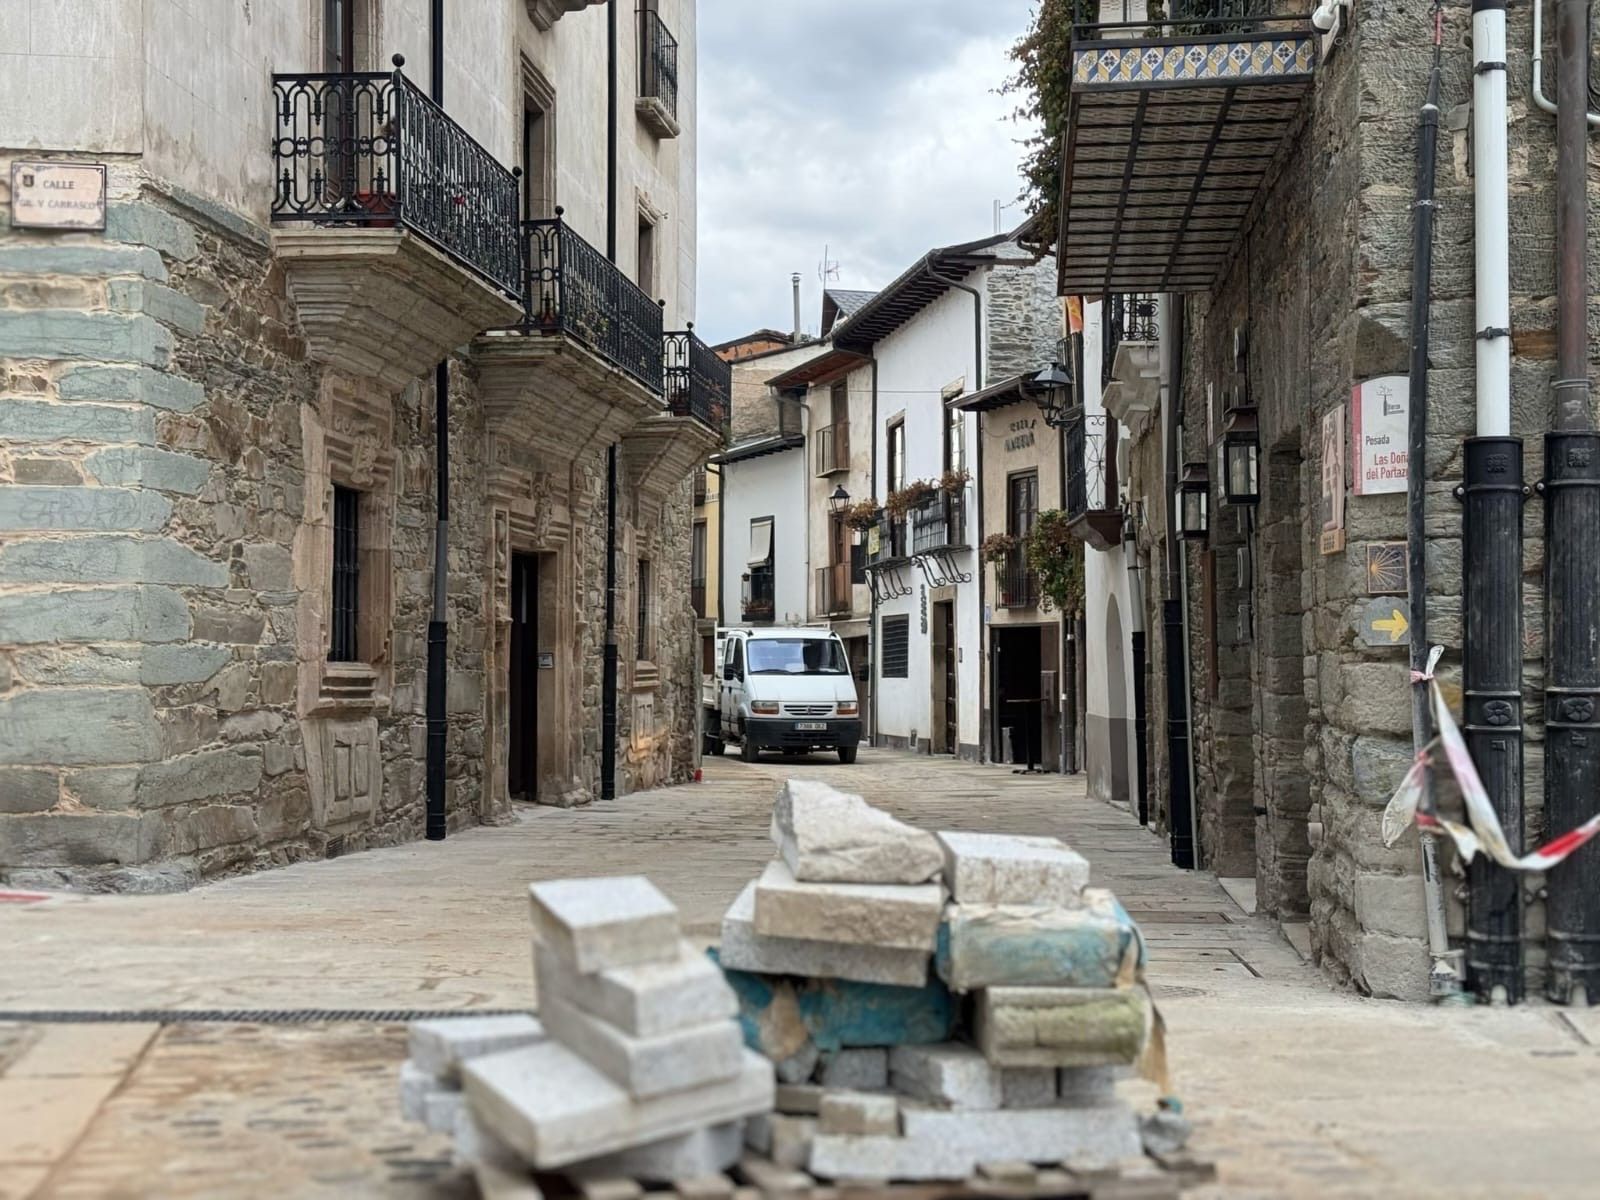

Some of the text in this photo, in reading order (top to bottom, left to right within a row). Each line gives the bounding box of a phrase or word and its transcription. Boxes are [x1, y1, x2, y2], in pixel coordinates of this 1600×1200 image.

[43, 180, 76, 190] CALLE
[37, 199, 45, 208] Y
[48, 199, 96, 209] CARRASCO
[1365, 434, 1390, 445] Posada
[1374, 454, 1388, 466] Las
[1366, 468, 1379, 480] del
